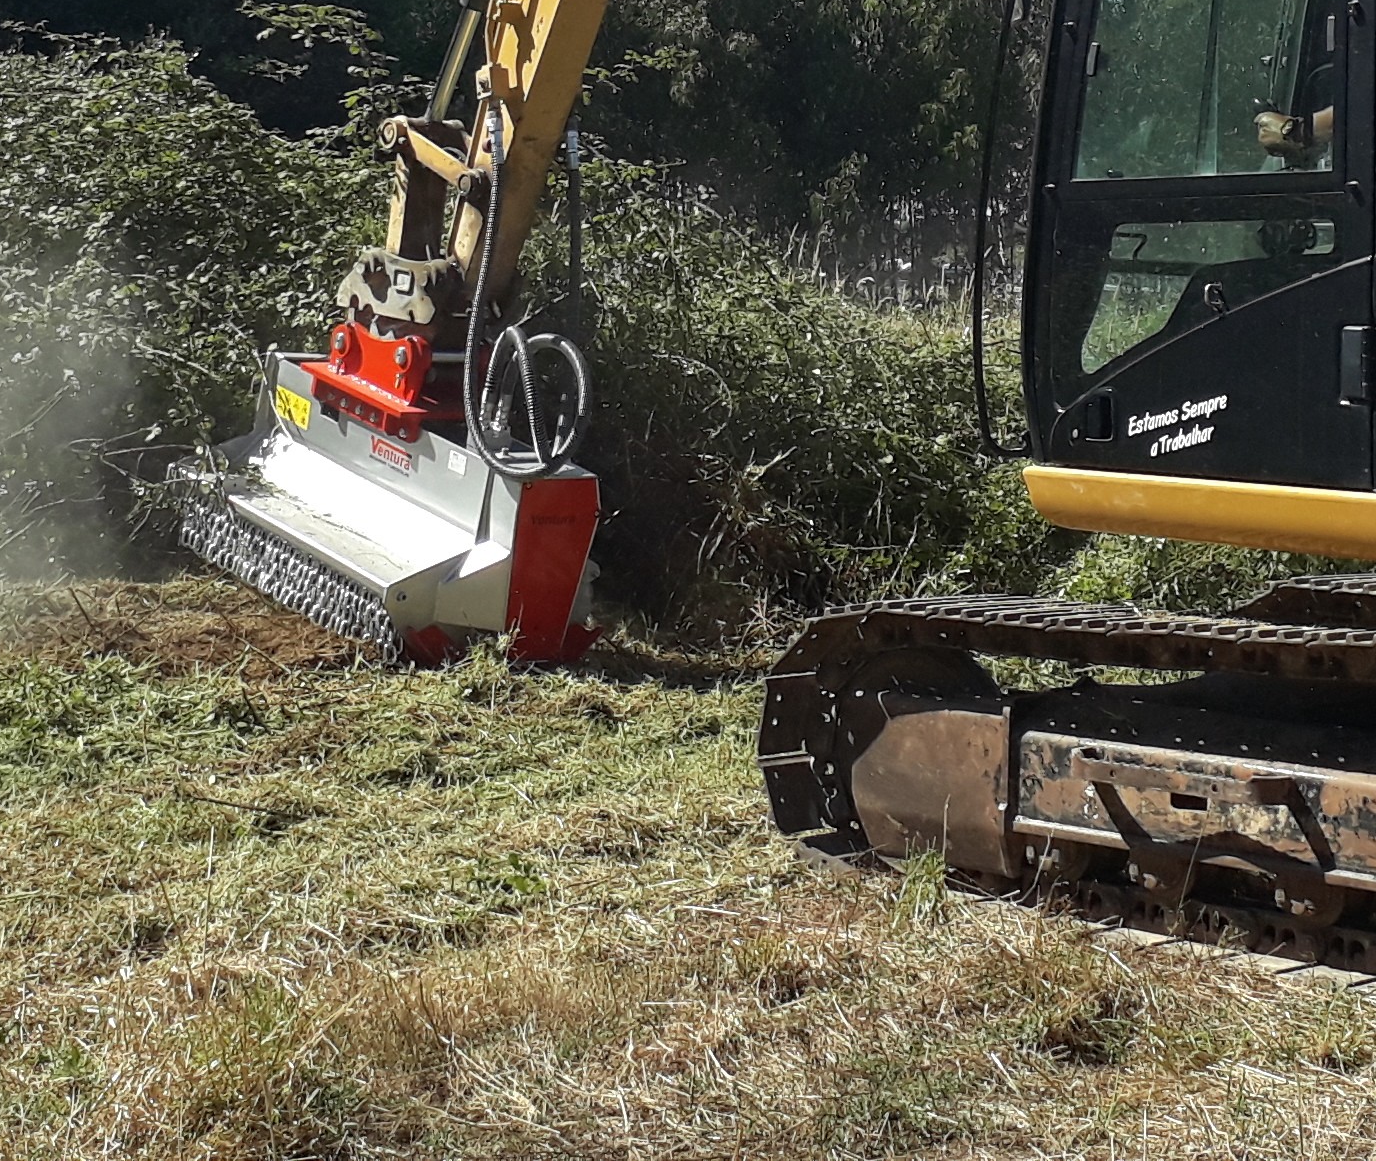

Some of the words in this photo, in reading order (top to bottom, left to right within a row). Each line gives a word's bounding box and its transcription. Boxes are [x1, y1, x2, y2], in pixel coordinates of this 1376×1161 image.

[1128, 409, 1179, 437] Estamos
[1181, 395, 1228, 421] Sempre
[370, 434, 412, 471] Ventura
[1150, 442, 1159, 457] a
[1159, 423, 1215, 454] Trabalhar
